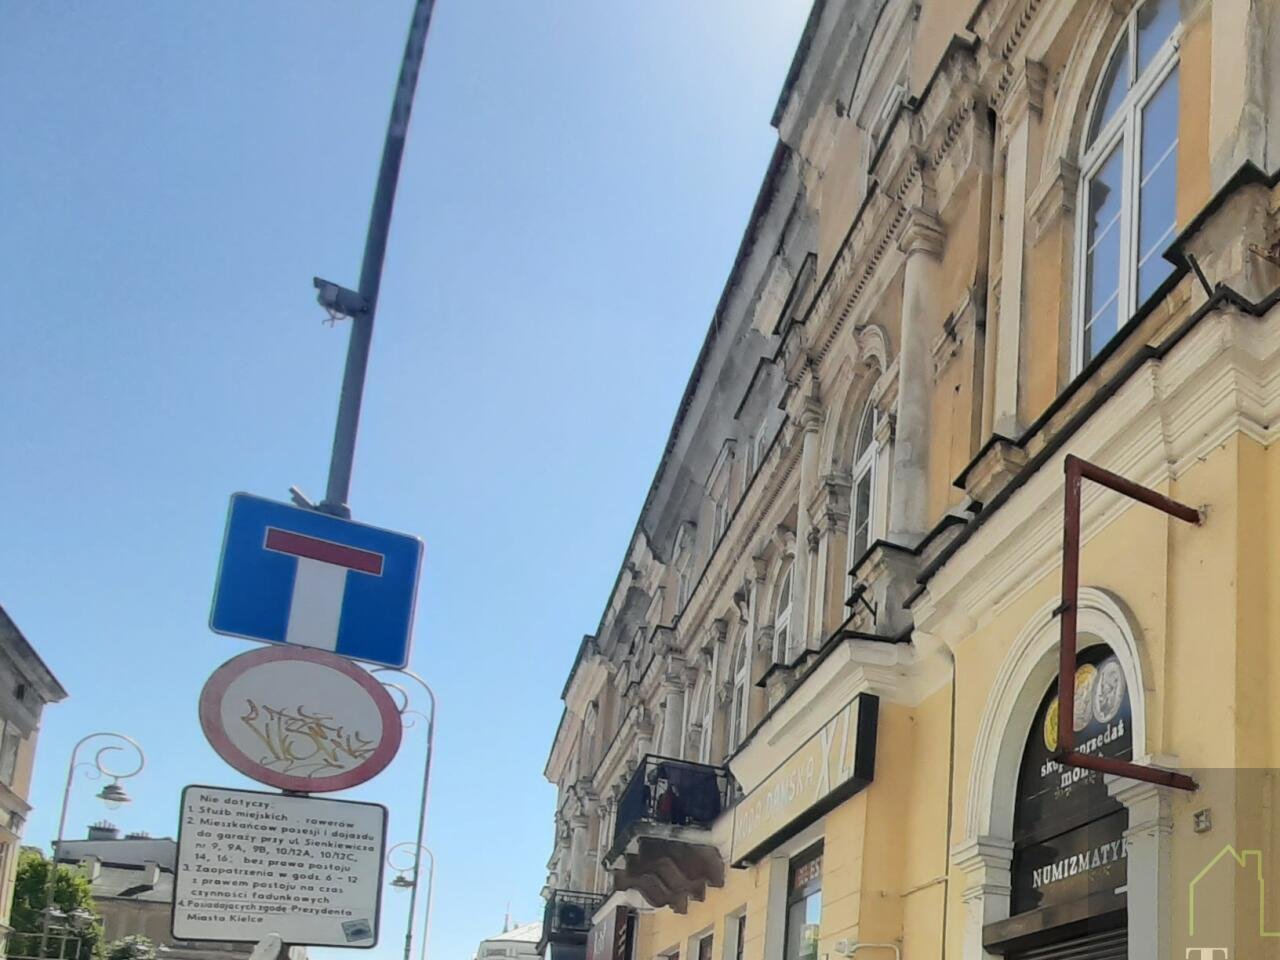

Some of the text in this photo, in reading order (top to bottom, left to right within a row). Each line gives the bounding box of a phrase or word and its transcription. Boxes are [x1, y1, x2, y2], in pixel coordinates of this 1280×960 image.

[200, 794, 220, 803] Nie
[236, 810, 288, 822] miejskich
[196, 830, 212, 838] do
[260, 836, 284, 846] przy
[304, 838, 375, 852] Sienkiewicza
[331, 830, 374, 841] dojazdu
[244, 857, 264, 865] bez
[268, 860, 304, 868] prawa
[308, 863, 352, 872] postoju
[196, 864, 274, 878] Zaopatrzenia
[348, 876, 358, 884] 12
[201, 878, 249, 886] prawem
[252, 881, 296, 891] postoju
[291, 904, 353, 916] Prezydenta
[186, 914, 264, 923] Miasta Kielce
